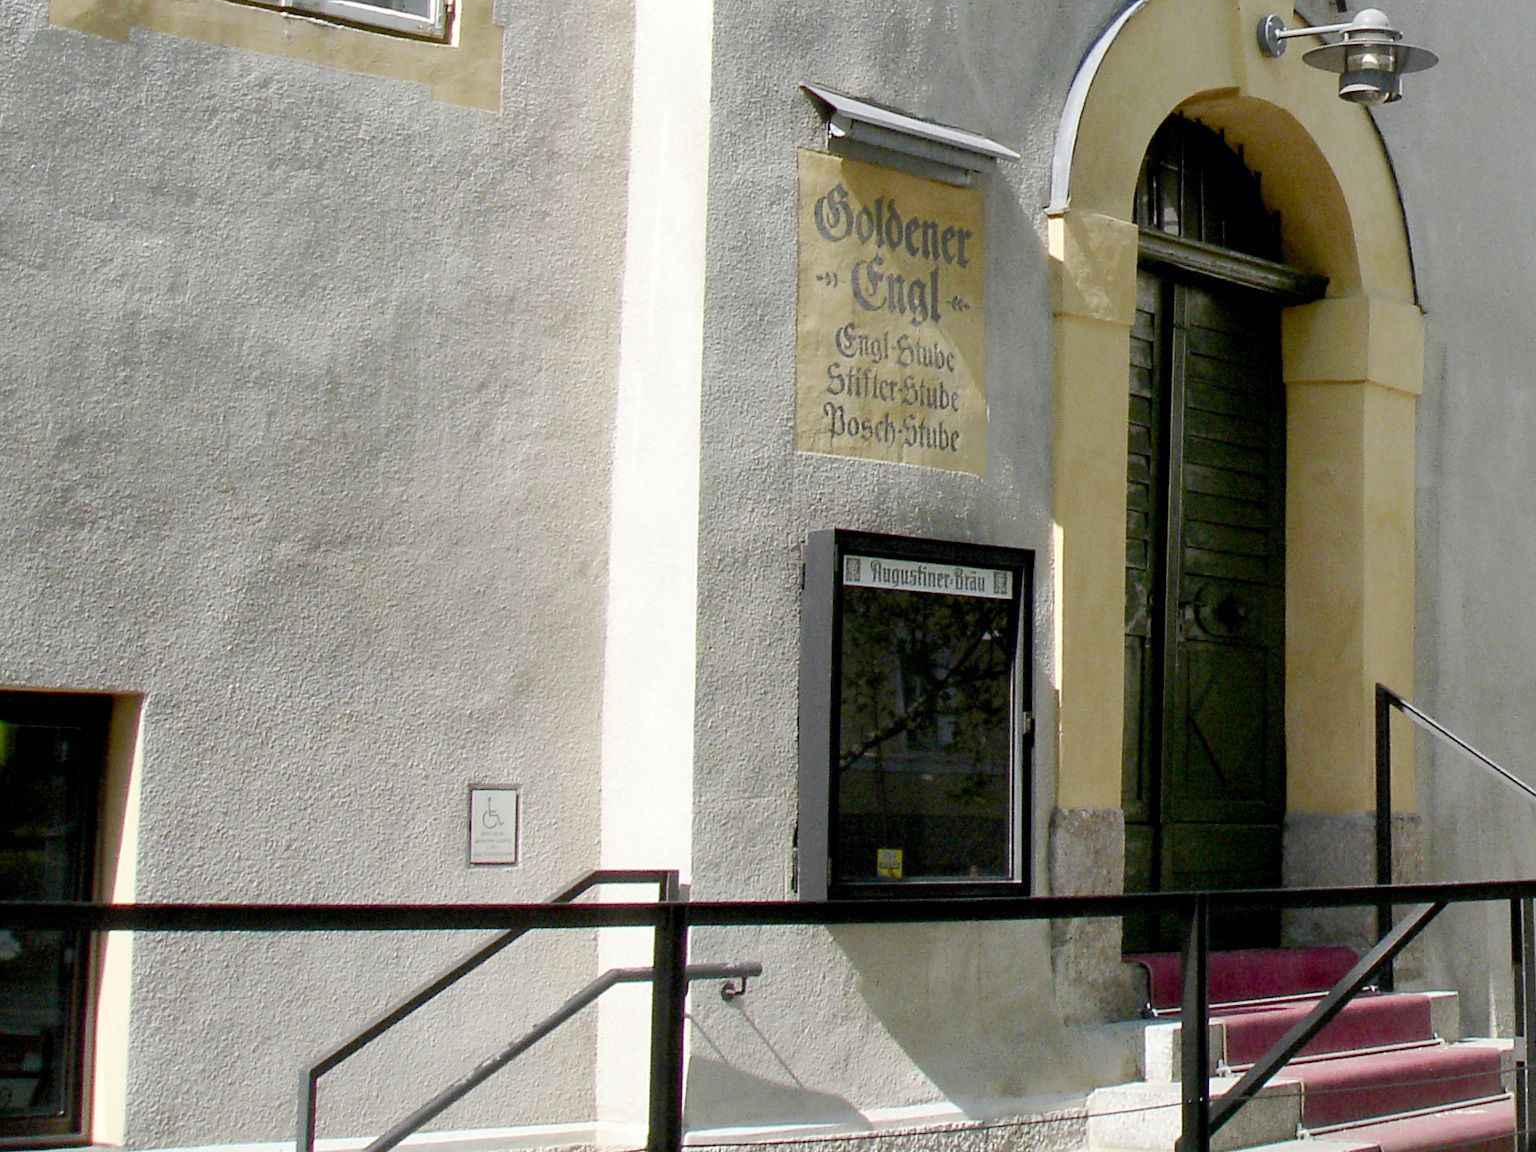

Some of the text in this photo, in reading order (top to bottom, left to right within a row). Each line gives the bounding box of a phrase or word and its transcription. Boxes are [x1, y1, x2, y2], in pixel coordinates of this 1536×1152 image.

[814, 183, 974, 269] Goldener
[851, 252, 942, 327] Engl
[835, 322, 956, 372] Engl-Stube
